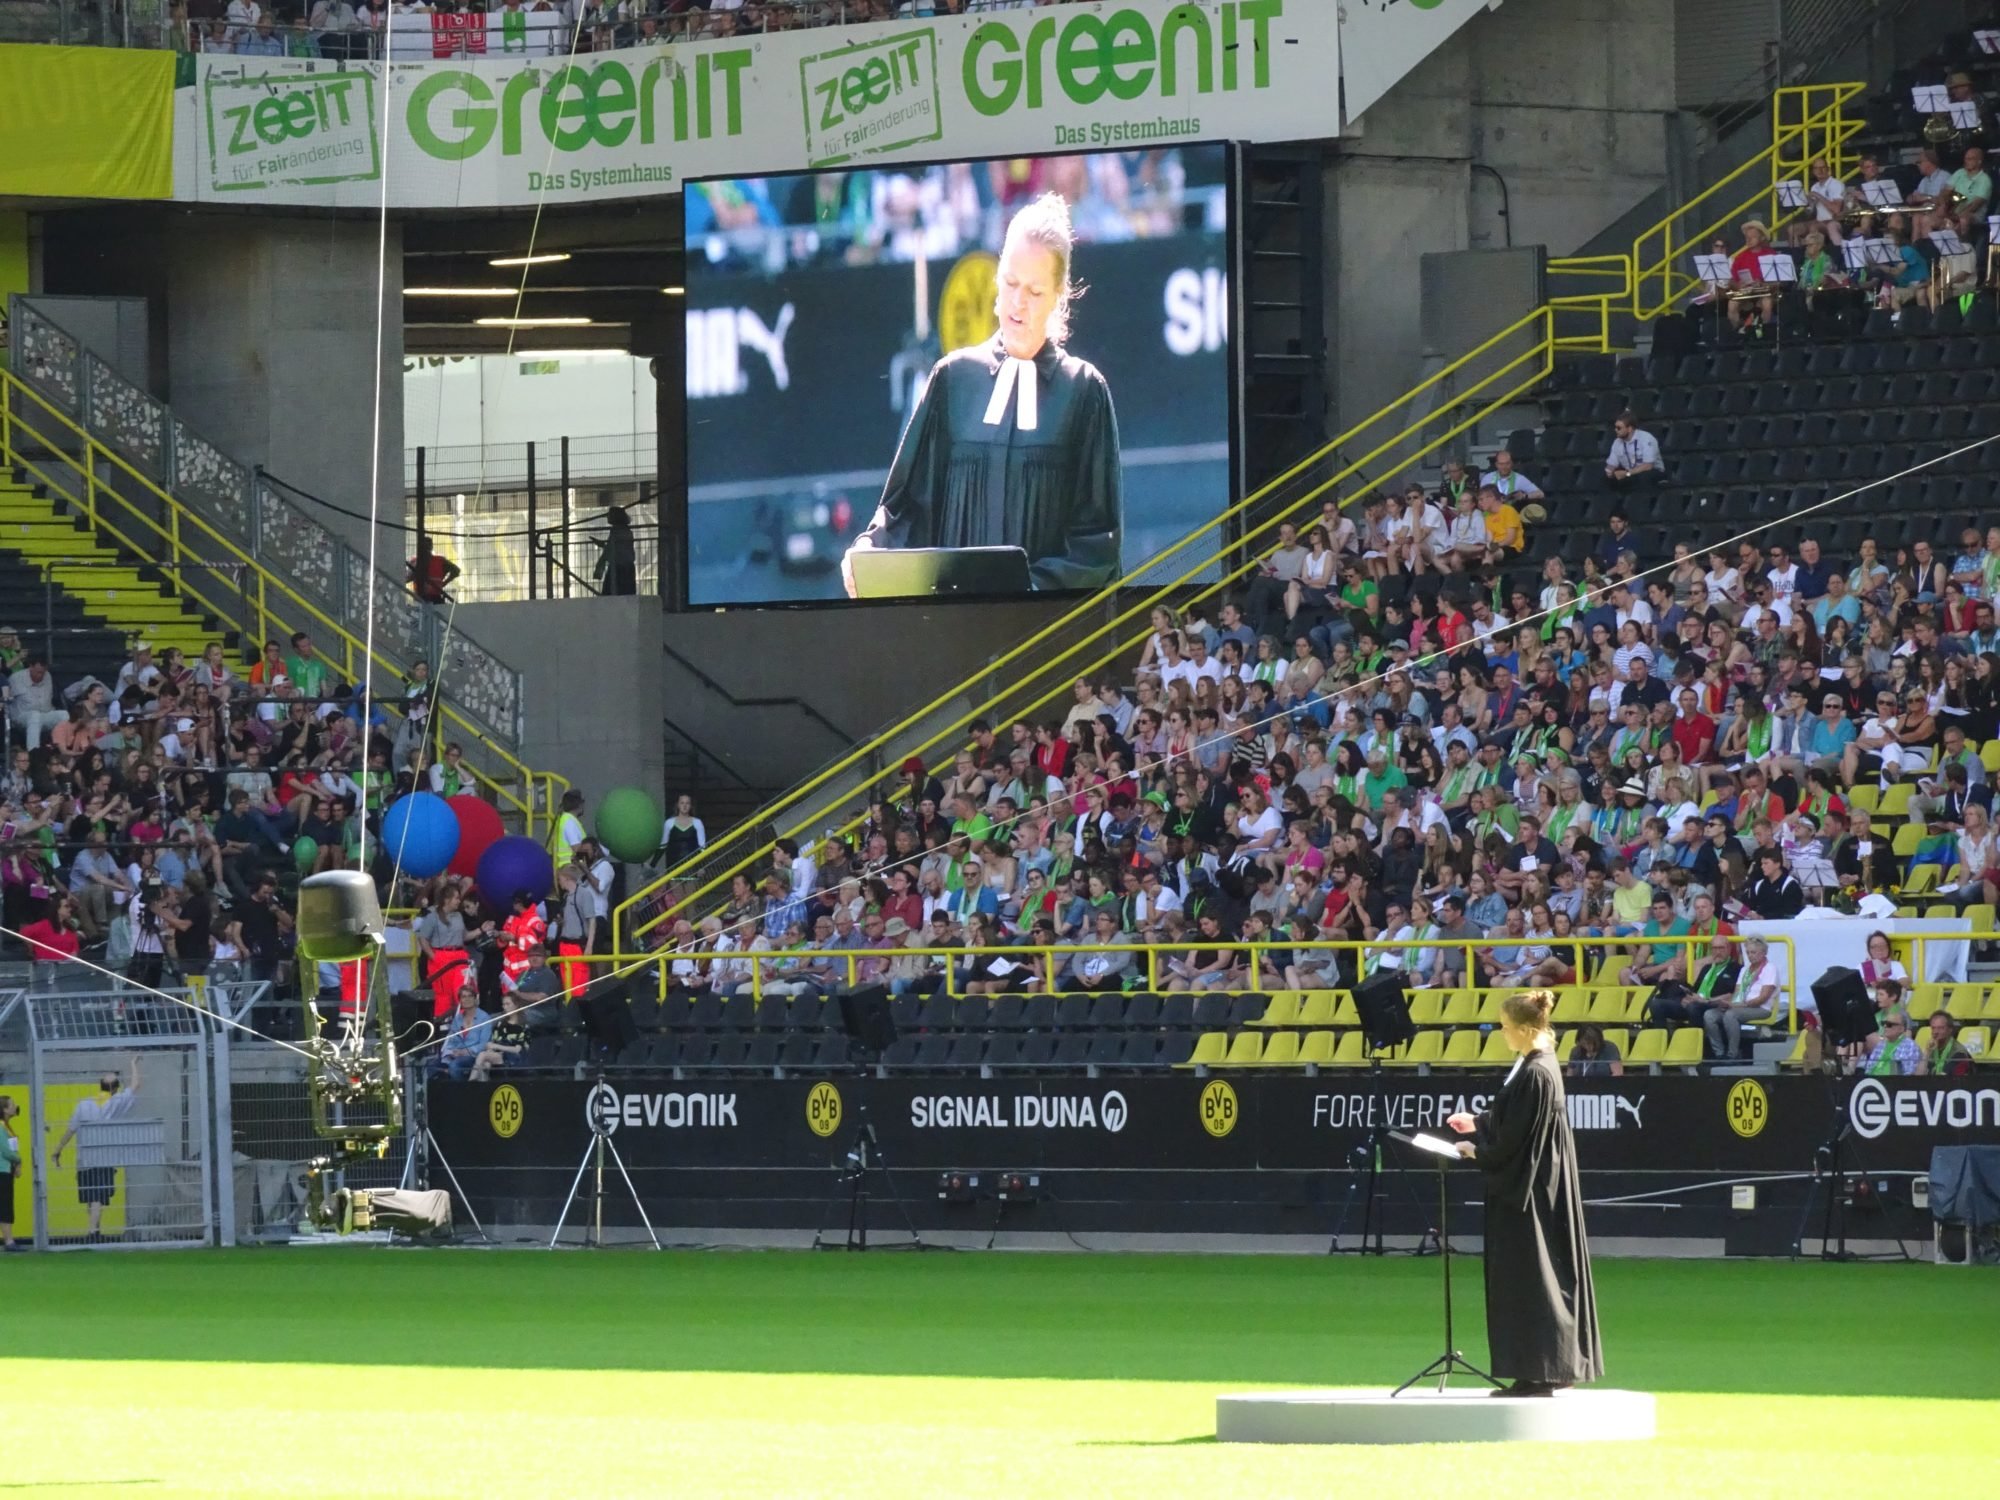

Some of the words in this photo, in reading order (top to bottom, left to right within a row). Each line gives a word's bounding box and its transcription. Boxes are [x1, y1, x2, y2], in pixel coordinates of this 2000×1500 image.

[844, 98, 930, 147] Fairänderung
[1055, 124, 1087, 146] Das
[1090, 116, 1200, 144] Systemhaus
[258, 138, 364, 175] Fairänderung
[528, 171, 565, 191] Das
[570, 163, 672, 192] Systemhaus
[1164, 267, 1228, 356] SI
[495, 1090, 519, 1121] BVB
[623, 1093, 738, 1127] EVONIK
[812, 1088, 838, 1120] BVB
[911, 1096, 1008, 1128] SIGNAL
[1014, 1096, 1097, 1128] IDUNA
[1205, 1087, 1233, 1119] BVB
[1733, 1086, 1762, 1119] BVB
[1213, 1118, 1224, 1130] 09
[1742, 1119, 1753, 1130] 09
